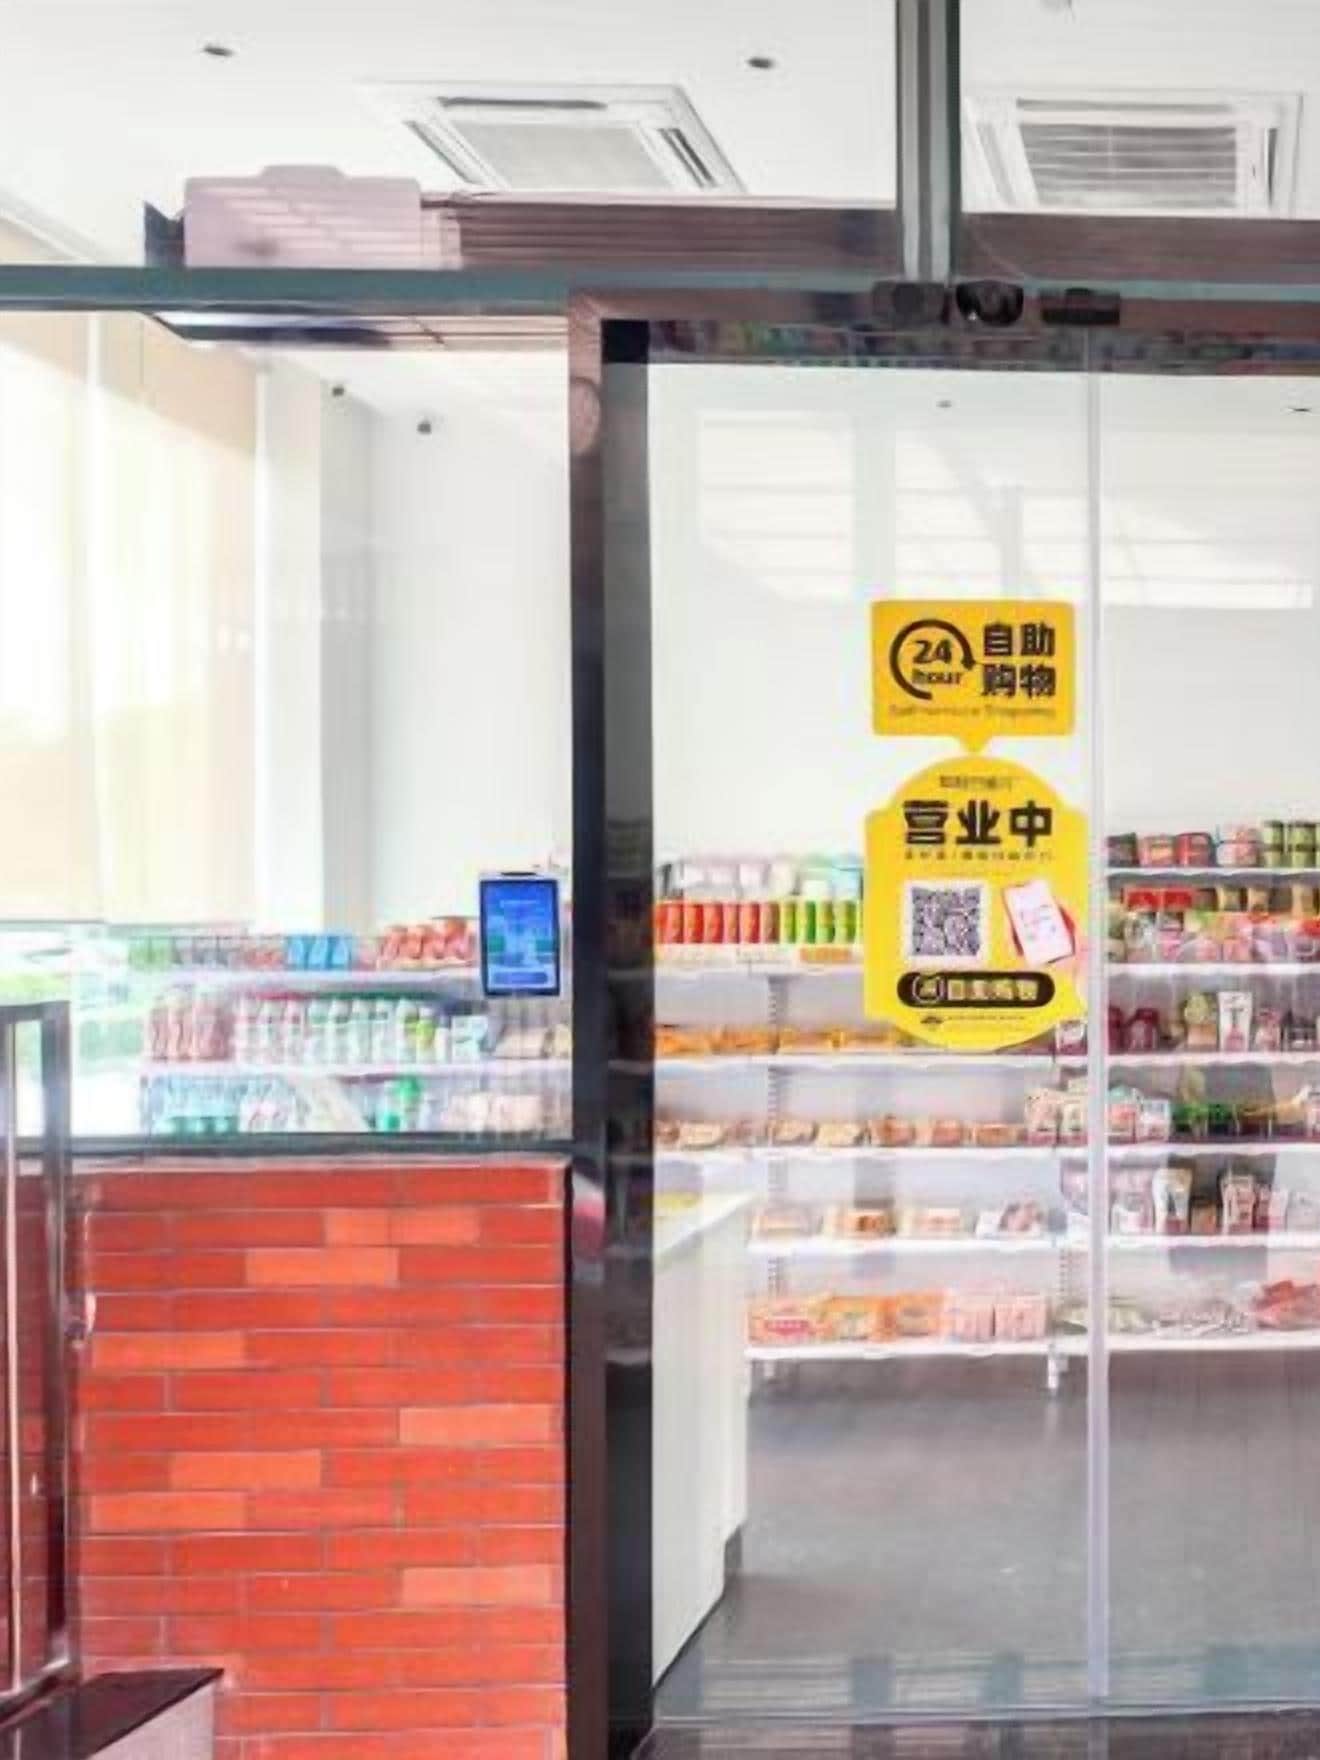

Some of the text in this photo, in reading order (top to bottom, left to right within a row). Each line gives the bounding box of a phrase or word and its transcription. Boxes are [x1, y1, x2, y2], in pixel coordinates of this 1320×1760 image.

[912, 639, 953, 664] 24
[983, 621, 1055, 657] 自助
[981, 663, 1056, 698] 购物
[903, 799, 1053, 848] 营业中
